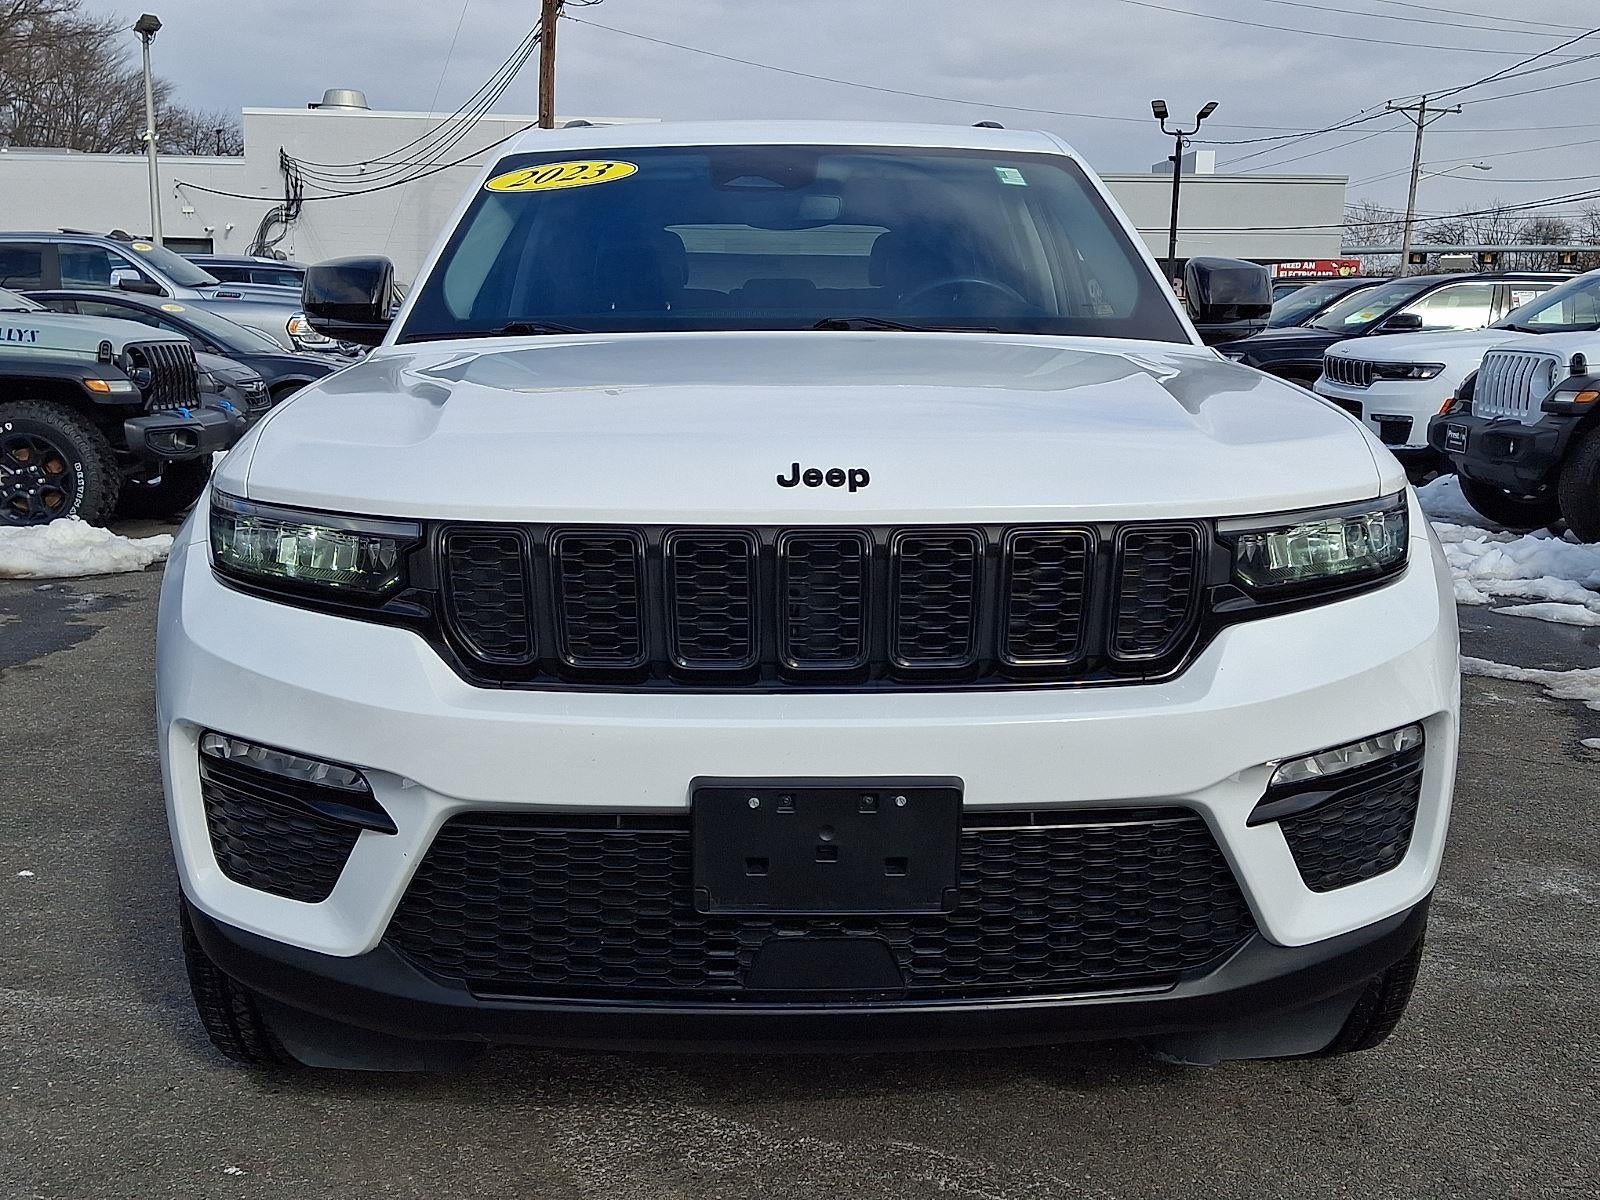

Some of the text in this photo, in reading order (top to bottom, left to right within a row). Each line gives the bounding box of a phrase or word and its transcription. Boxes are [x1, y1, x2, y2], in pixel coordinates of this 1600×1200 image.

[504, 163, 615, 189] 2023
[1302, 261, 1316, 269] AN
[776, 462, 871, 493] Jeep
